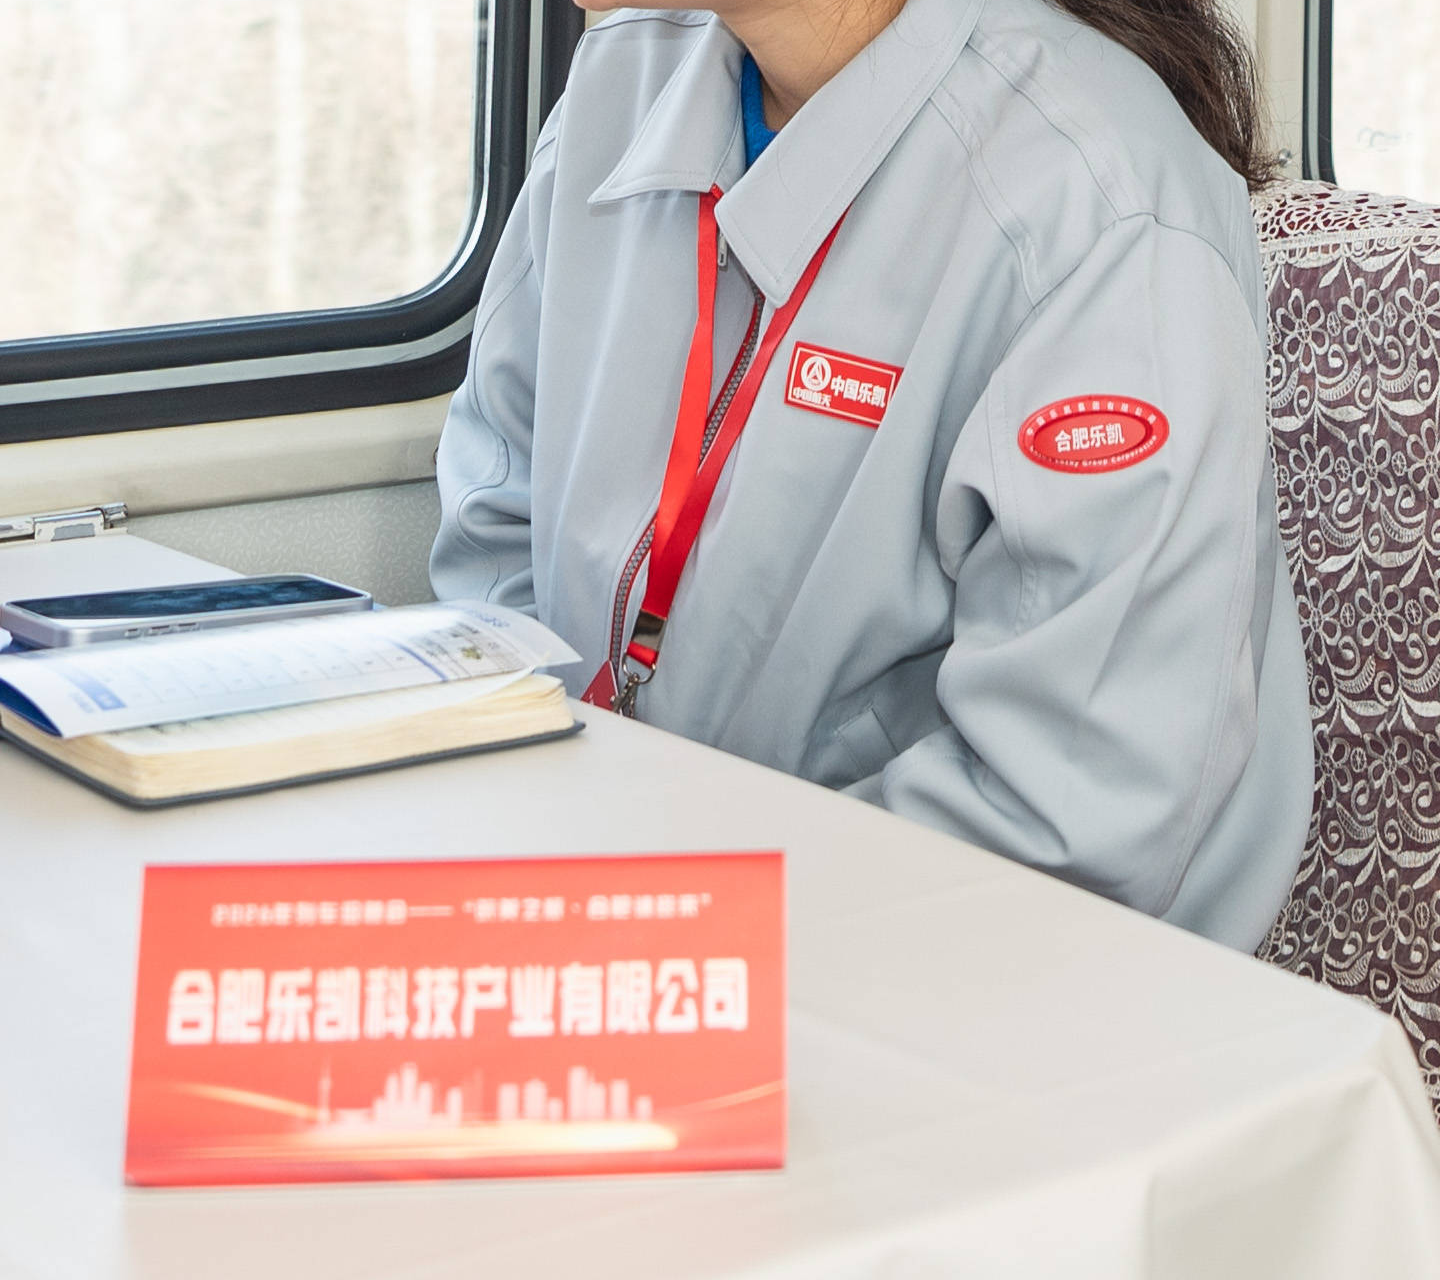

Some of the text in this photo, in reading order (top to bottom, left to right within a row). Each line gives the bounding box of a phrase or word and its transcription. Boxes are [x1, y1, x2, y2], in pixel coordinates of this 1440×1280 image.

[830, 374, 887, 408] 中国乐凯
[1054, 423, 1125, 453] 合肥乐凯
[166, 957, 749, 1045] 合肥乐凯科技产业有限公司
